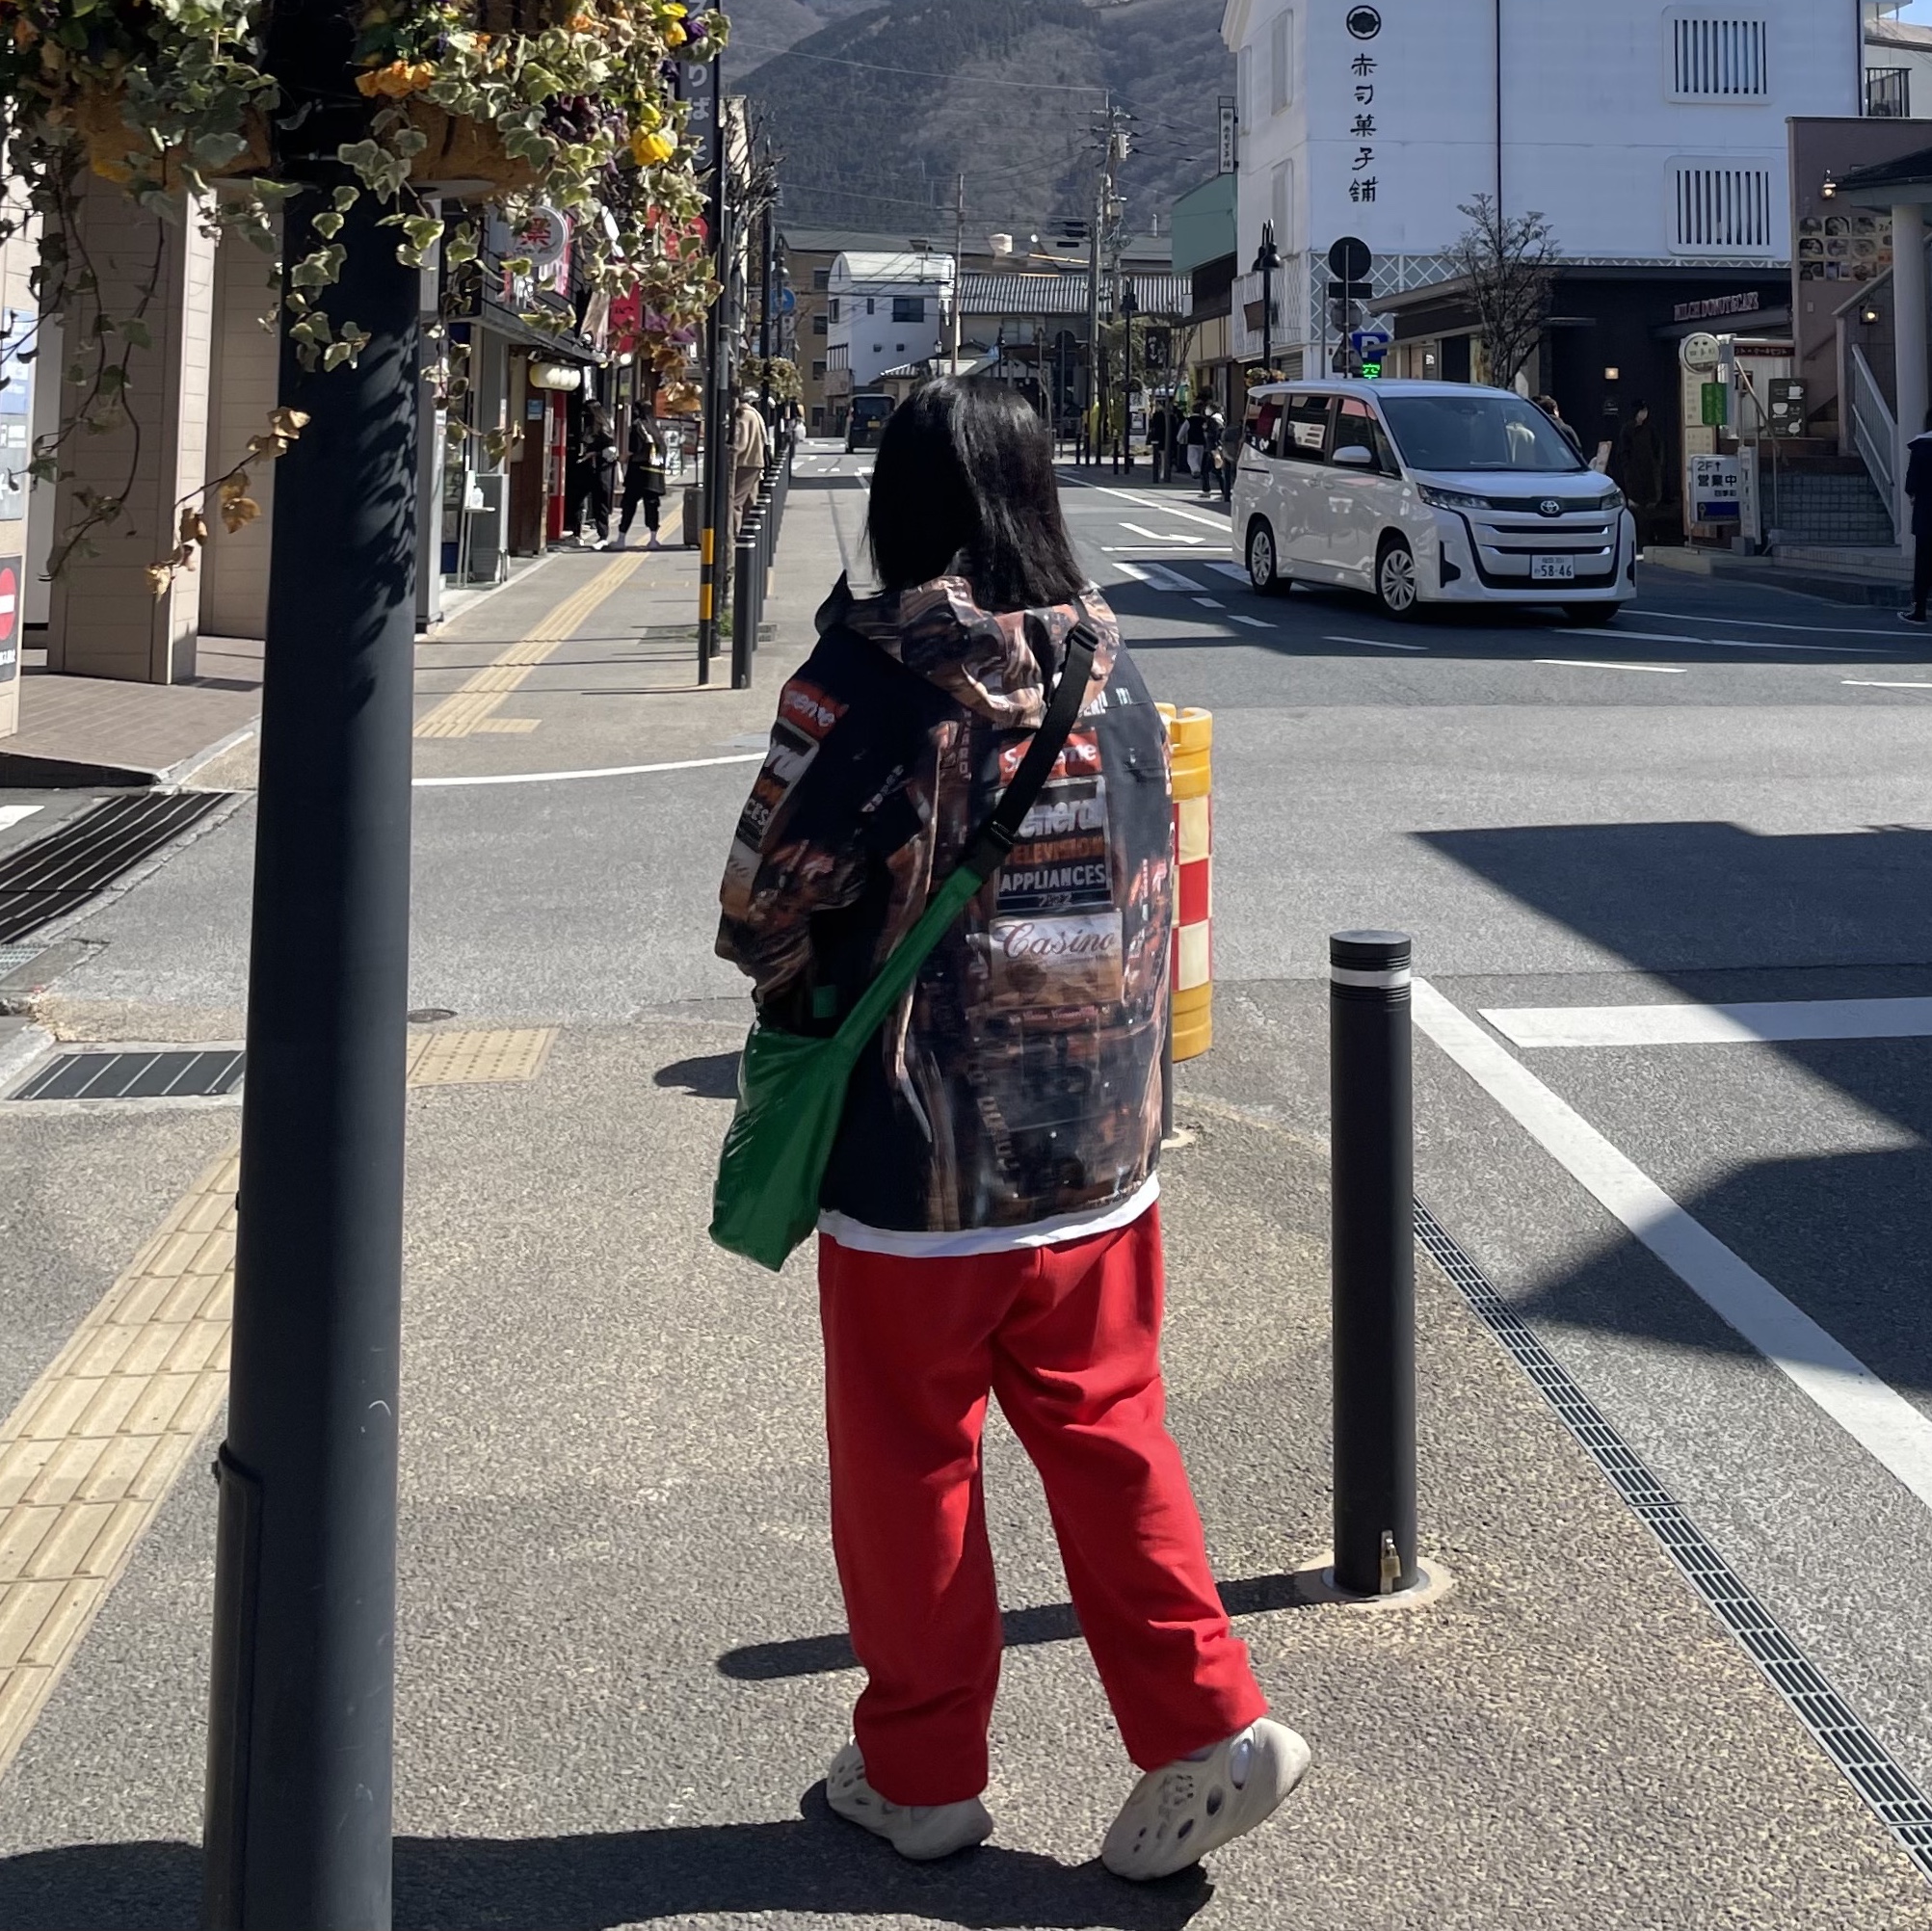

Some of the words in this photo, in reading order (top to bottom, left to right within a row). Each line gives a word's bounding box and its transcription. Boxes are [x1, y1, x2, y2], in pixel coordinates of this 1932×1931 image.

[1349, 53, 1379, 202] 赤司菓子舗
[1363, 363, 1381, 380] 空
[1697, 461, 1713, 472] 2F
[1697, 474, 1737, 487] 営業中
[999, 863, 1106, 893] APPLIANCES
[992, 922, 1115, 959] Casino
